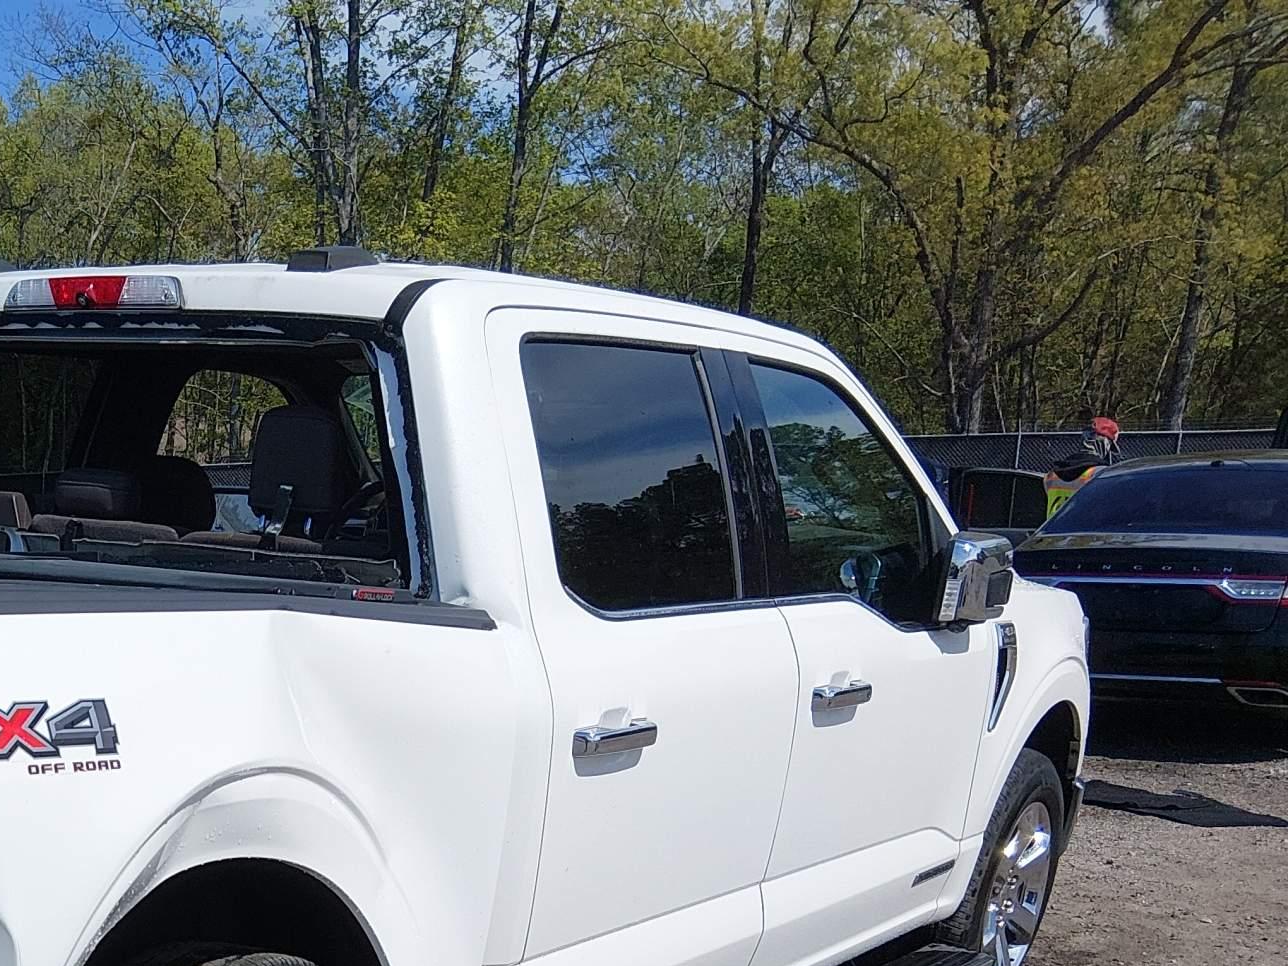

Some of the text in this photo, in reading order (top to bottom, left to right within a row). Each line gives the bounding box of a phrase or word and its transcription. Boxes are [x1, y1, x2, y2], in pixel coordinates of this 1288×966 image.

[1051, 564, 1233, 573] LINCOLN
[27, 759, 122, 775] OFF ROAD
